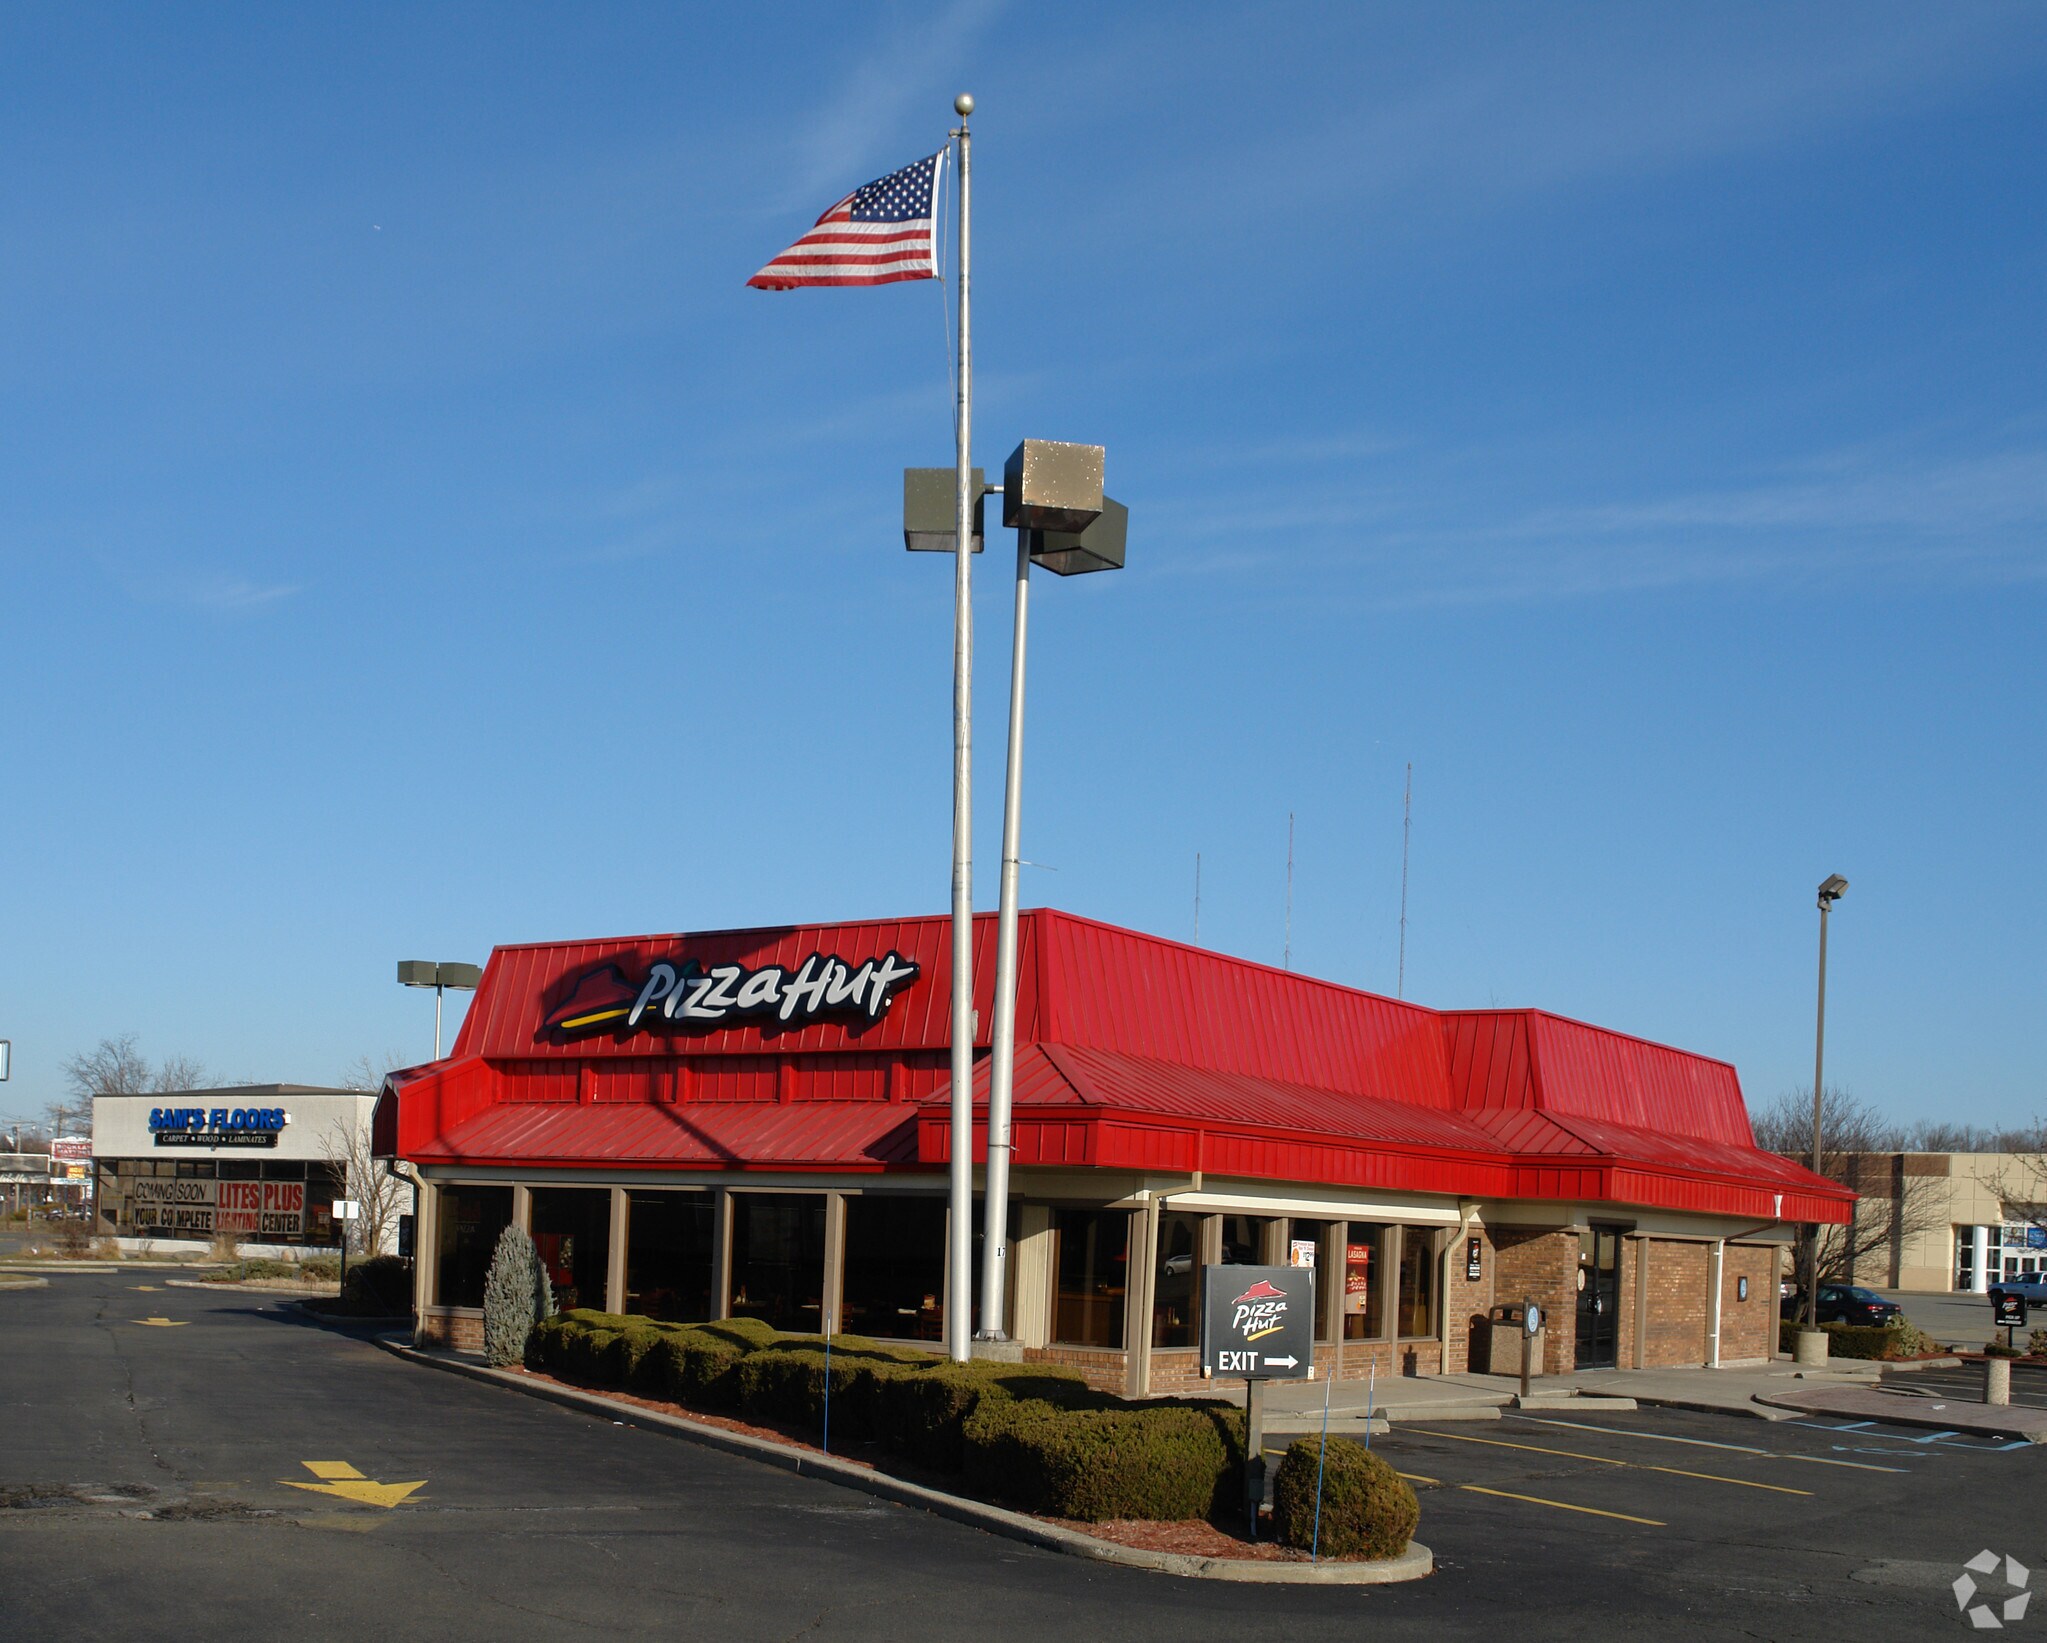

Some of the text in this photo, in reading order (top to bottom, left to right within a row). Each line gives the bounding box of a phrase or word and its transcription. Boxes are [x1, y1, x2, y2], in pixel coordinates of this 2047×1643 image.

[628, 953, 914, 1026] Pizza Hut
[150, 1107, 286, 1130] SAM'S FLOORS
[162, 1134, 267, 1144] CARPET WOOD LAMINATES
[136, 1182, 303, 1212] COMING SOON LITES PLUS
[135, 1207, 157, 1226] YOUR
[216, 1212, 258, 1230] LIGHTING
[262, 1213, 300, 1232] CENTER
[1348, 1250, 1367, 1259] LASAGNA
[1232, 1302, 1288, 1329] Pizza
[1242, 1314, 1282, 1336] Hut
[1219, 1351, 1259, 1371] EXIT
